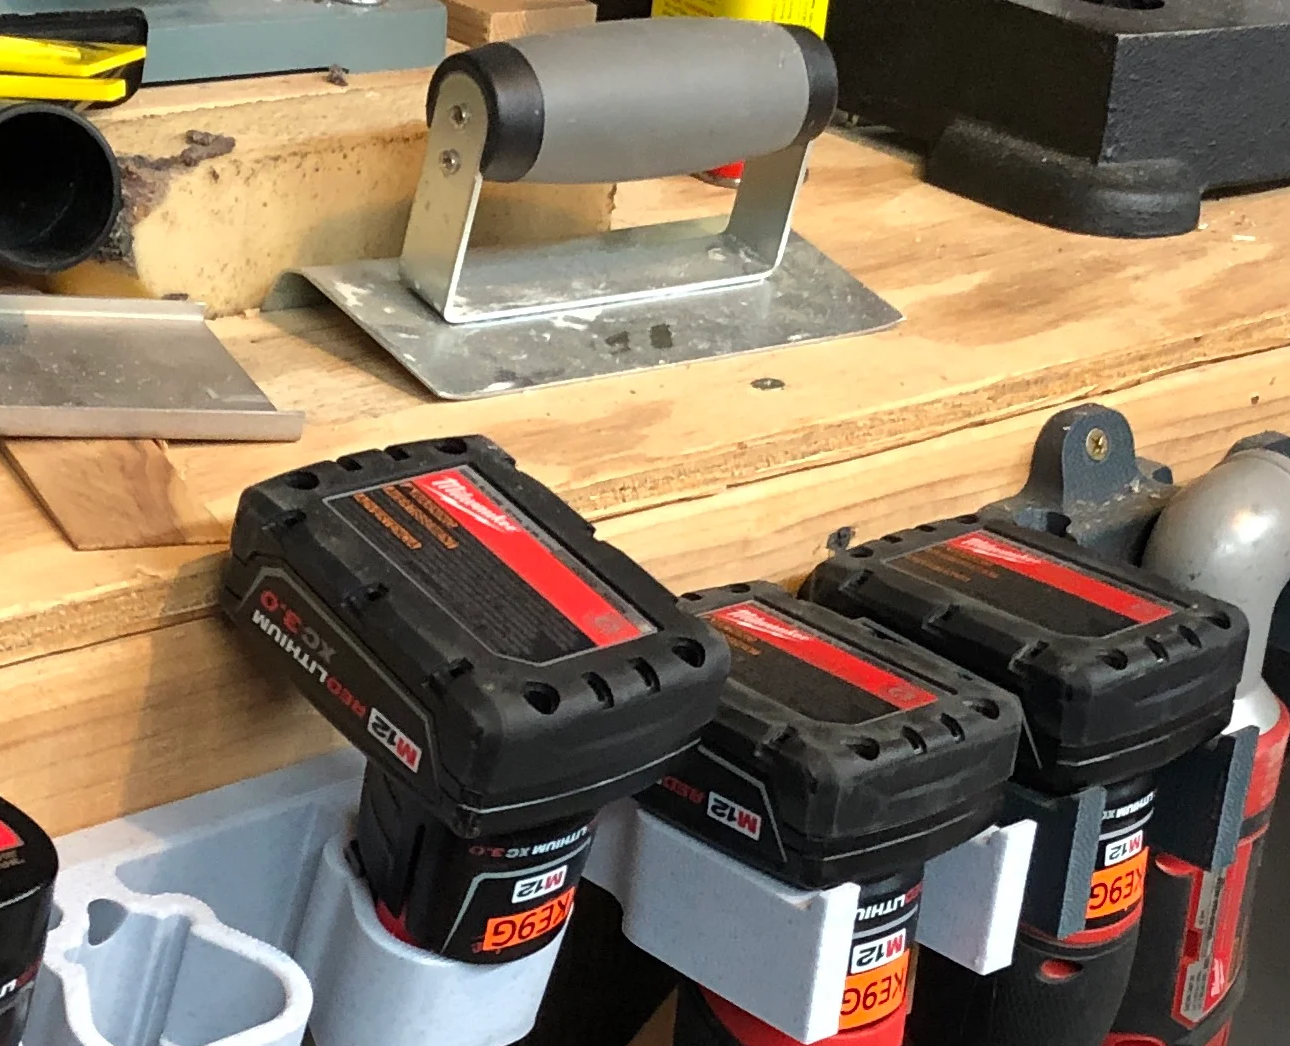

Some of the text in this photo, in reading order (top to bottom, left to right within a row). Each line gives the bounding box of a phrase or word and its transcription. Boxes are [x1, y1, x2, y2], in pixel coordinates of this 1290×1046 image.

[431, 476, 521, 533] Milwaukee
[371, 714, 418, 767] M12
[711, 796, 758, 835] M12
[1109, 833, 1141, 861] M12
[516, 871, 562, 898] M12
[1088, 869, 1143, 910] KE9G
[491, 891, 571, 948] KE9G
[855, 933, 904, 968] M12
[839, 967, 906, 1017] KE9G
